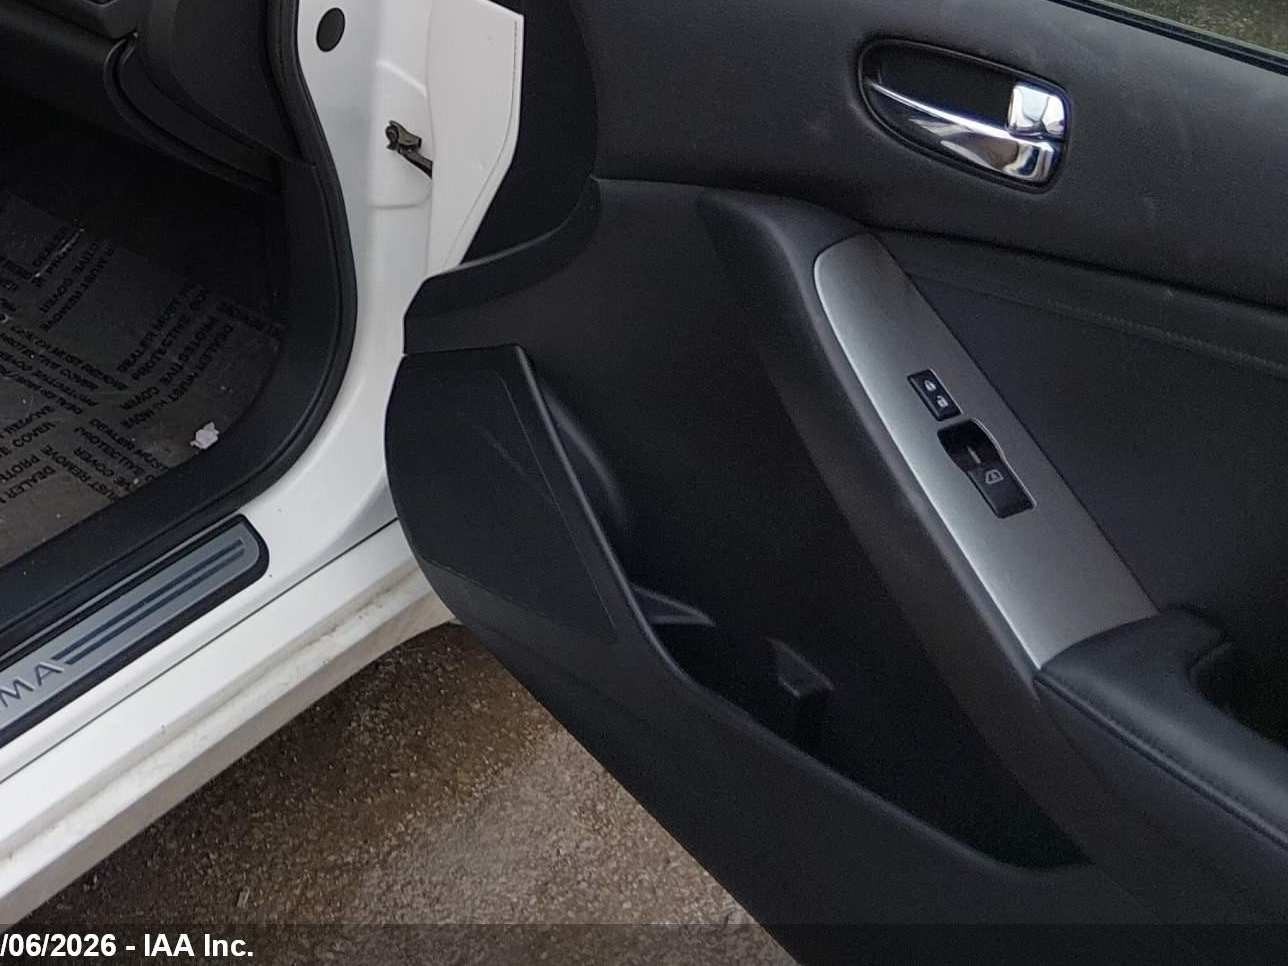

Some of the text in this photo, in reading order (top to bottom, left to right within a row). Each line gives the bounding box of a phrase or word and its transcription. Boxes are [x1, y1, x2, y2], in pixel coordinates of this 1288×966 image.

[12, 420, 57, 448] COVER
[88, 418, 136, 451] DEALER
[40, 444, 91, 484] REMOVE
[73, 426, 145, 476] PROTECTIVE
[73, 446, 115, 479] COVER
[4, 465, 57, 500] DEALER
[89, 476, 118, 501] UST
